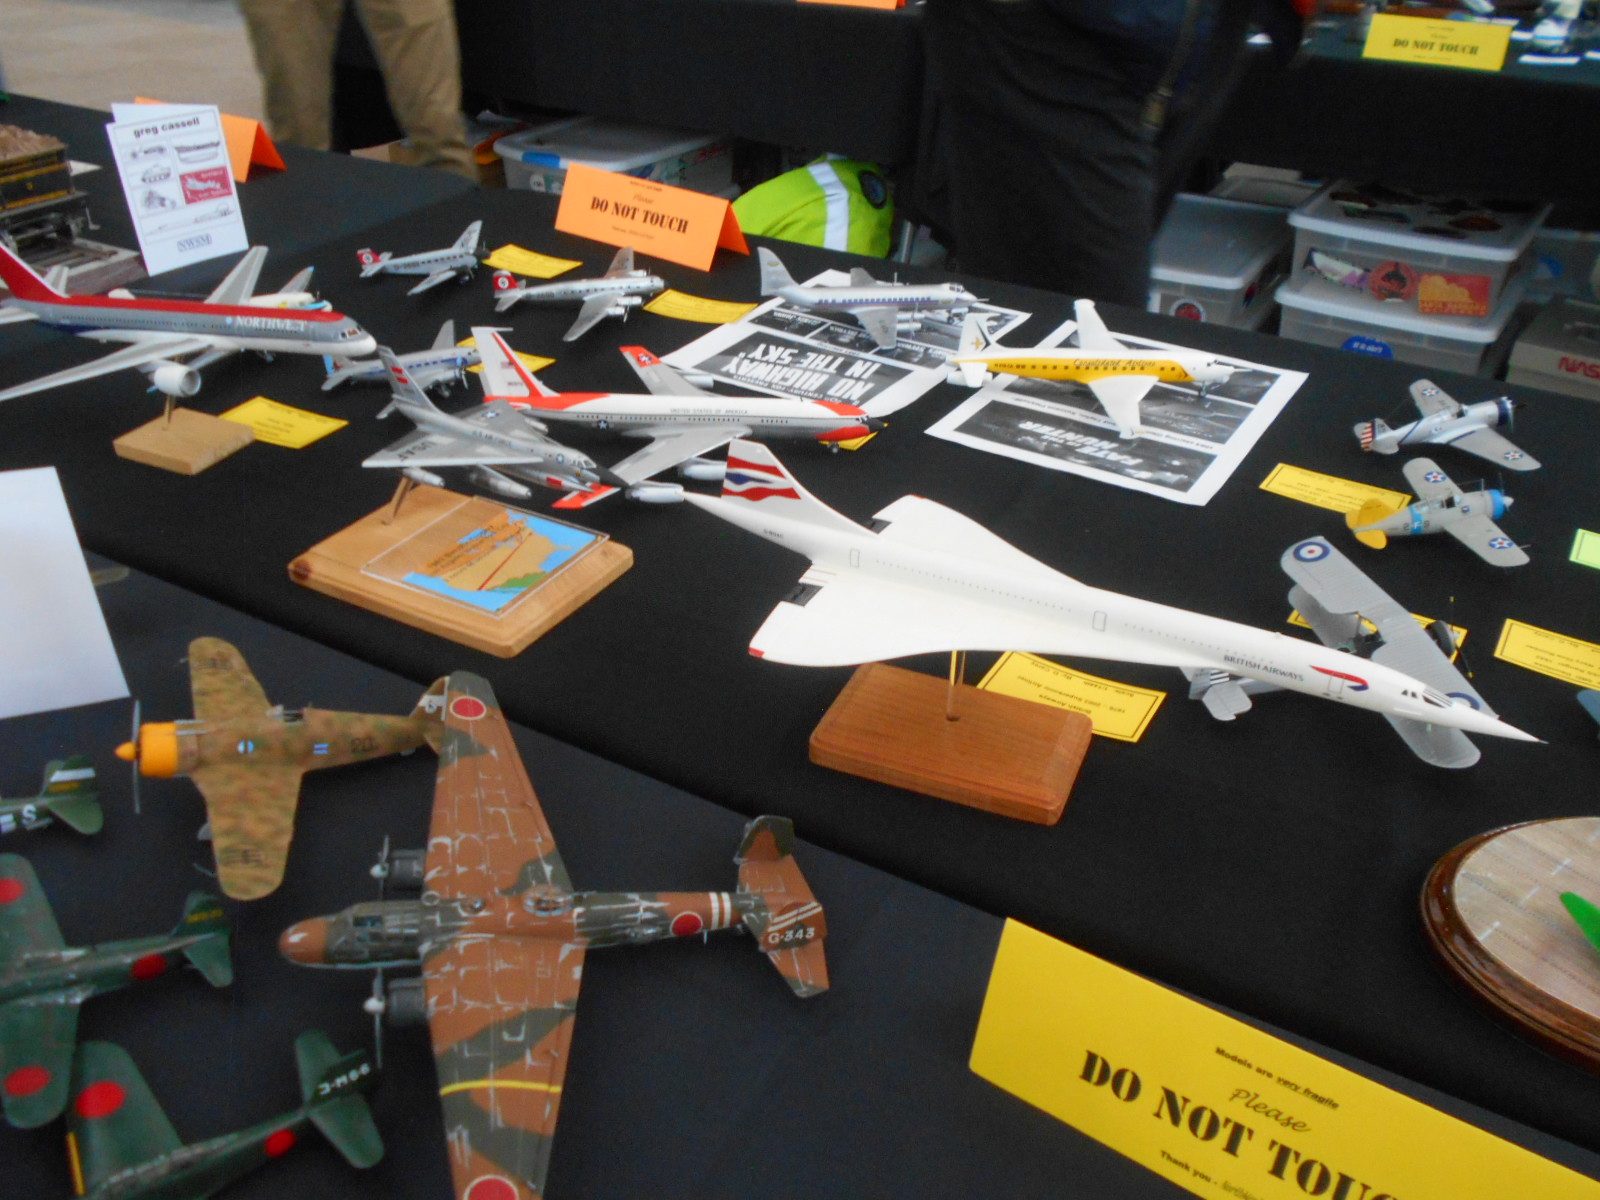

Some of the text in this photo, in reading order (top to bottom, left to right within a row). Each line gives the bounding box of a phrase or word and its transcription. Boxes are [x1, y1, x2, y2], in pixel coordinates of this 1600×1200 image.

[1393, 38, 1480, 55] DO NOT TOUCH
[133, 117, 200, 139] greg cassell
[590, 196, 609, 213] DO
[611, 201, 640, 221] NOT
[641, 210, 690, 234] TOUCH
[721, 356, 830, 392] HIGHWAY
[792, 352, 845, 374] THE
[844, 359, 882, 379] IN
[1558, 356, 1600, 379] NAS
[1223, 654, 1305, 683] BRITISH AIRWAYS
[1039, 694, 1067, 707] Airways
[1215, 1047, 1340, 1110] Models are very fragile
[1078, 1049, 1142, 1103] DO
[1152, 1085, 1255, 1158] NOT
[1229, 1088, 1312, 1132] Please
[1160, 1150, 1191, 1172] Thank
[1191, 1166, 1212, 1184] you
